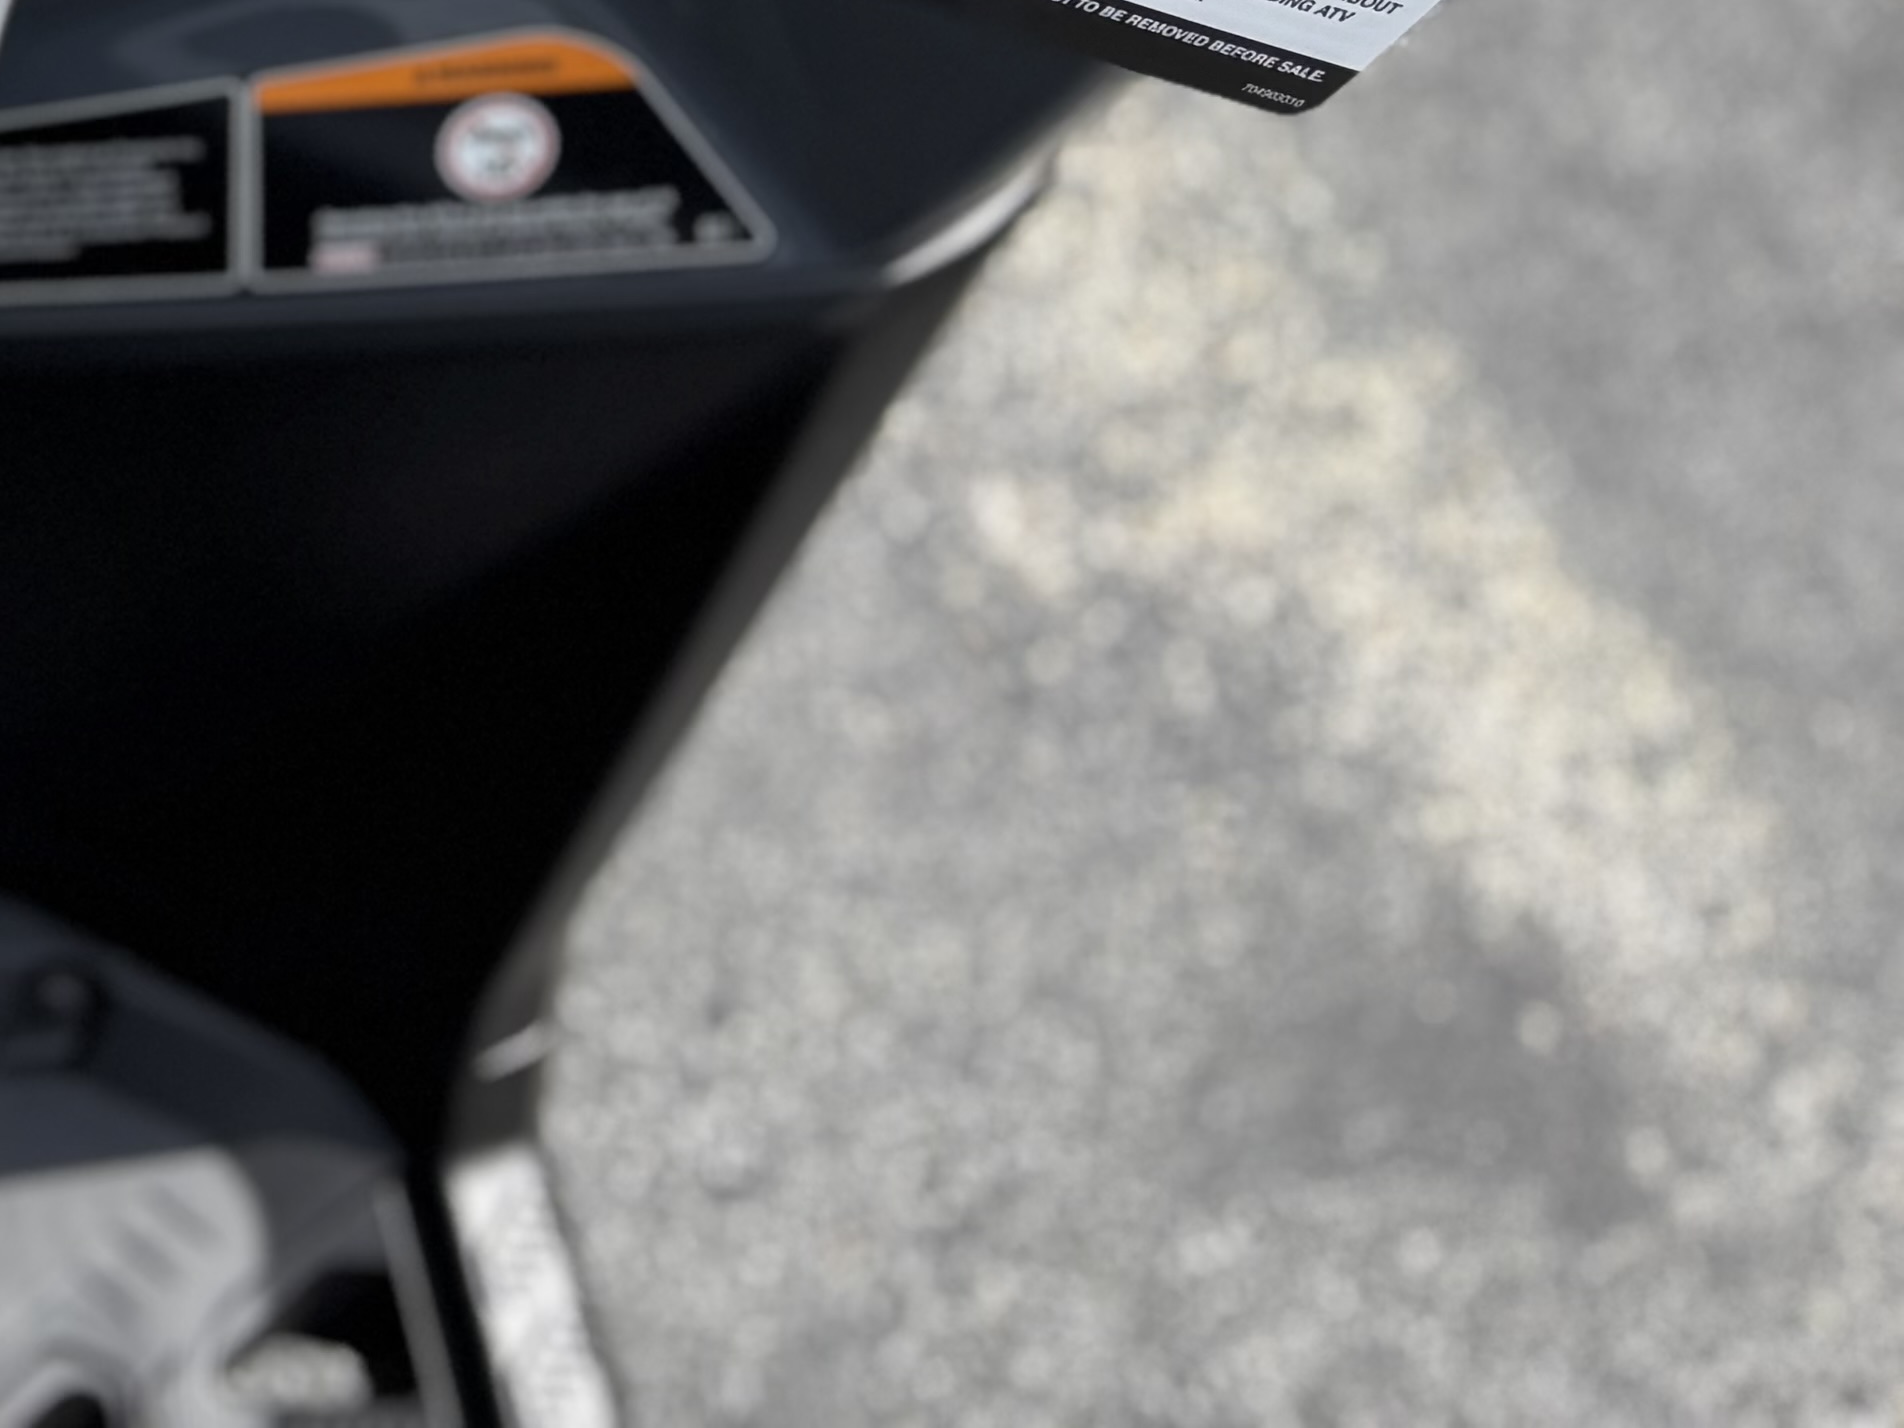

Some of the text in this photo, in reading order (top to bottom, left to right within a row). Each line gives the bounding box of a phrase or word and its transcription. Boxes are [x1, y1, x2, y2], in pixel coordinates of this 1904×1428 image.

[1314, 5, 1356, 22] ATV
[1099, 6, 1125, 22] BE
[1126, 14, 1210, 47] REMOVED
[1208, 40, 1279, 68] BEFORE
[1278, 61, 1325, 82] SALE
